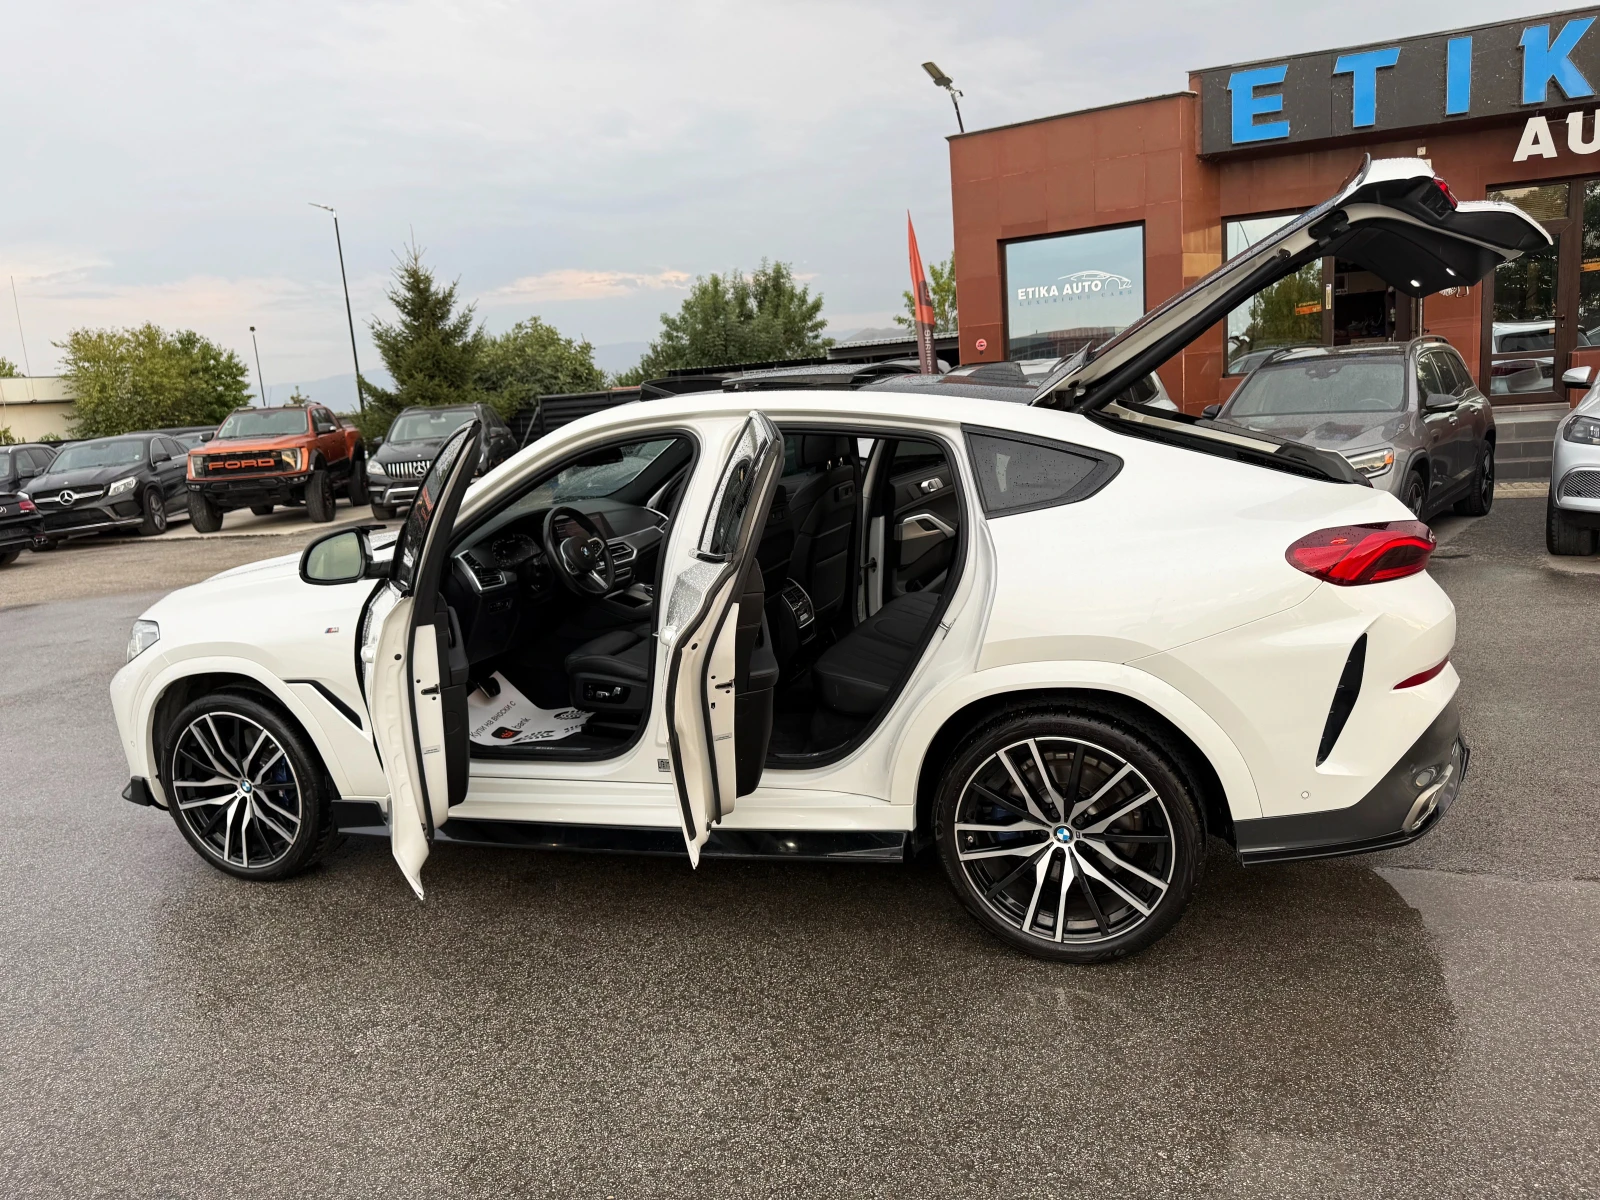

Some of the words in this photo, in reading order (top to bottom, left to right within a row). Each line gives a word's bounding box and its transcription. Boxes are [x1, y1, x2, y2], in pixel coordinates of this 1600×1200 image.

[1227, 16, 1598, 144] ETIK
[1017, 285, 1059, 300] ETIKA
[1062, 280, 1102, 296] AUTO
[208, 458, 275, 471] FORD
[470, 726, 487, 738] Купи
[490, 704, 513, 722] вноски
